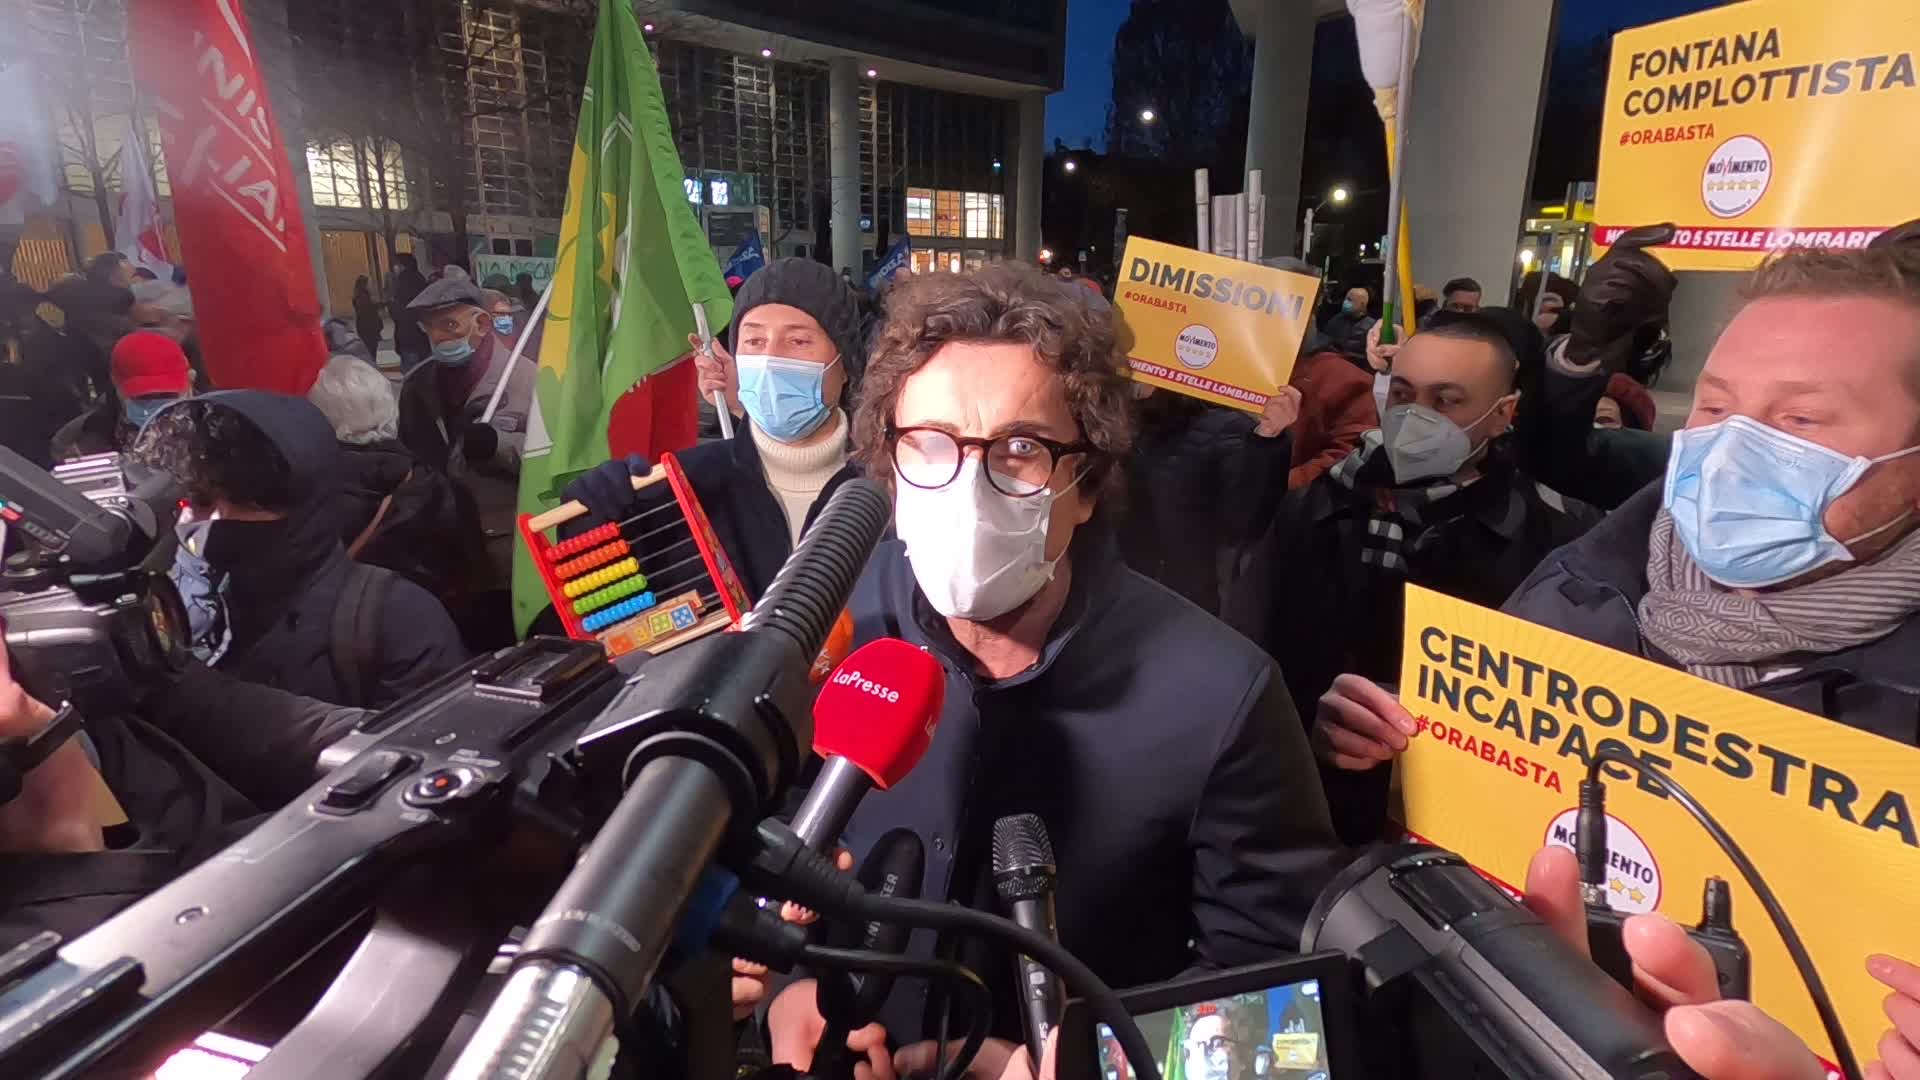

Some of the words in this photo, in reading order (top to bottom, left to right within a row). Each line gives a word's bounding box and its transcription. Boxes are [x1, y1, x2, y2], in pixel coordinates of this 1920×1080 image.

[1628, 27, 1781, 81] FONTANA
[1623, 53, 1916, 117] COMPLOTTISTA
[1619, 123, 1715, 146] #ORABASTA
[1707, 156, 1768, 176] MOVIMENTO
[1691, 230, 1701, 246] 5
[1702, 230, 1765, 248] STELLE
[1123, 290, 1188, 315] #ORABASTA
[1128, 257, 1304, 321] DIMISSIONI
[1128, 359, 1167, 377] IMENTO
[1175, 373, 1214, 391] STELLE
[1212, 383, 1268, 405] LOMBARDI
[833, 668, 900, 703] LaPresse
[1415, 713, 1563, 794] #ORABASTA
[1417, 664, 1673, 800] INCAPACE
[1419, 626, 1920, 848] CENTRODESTRA
[1553, 824, 1654, 884] MOENTO
